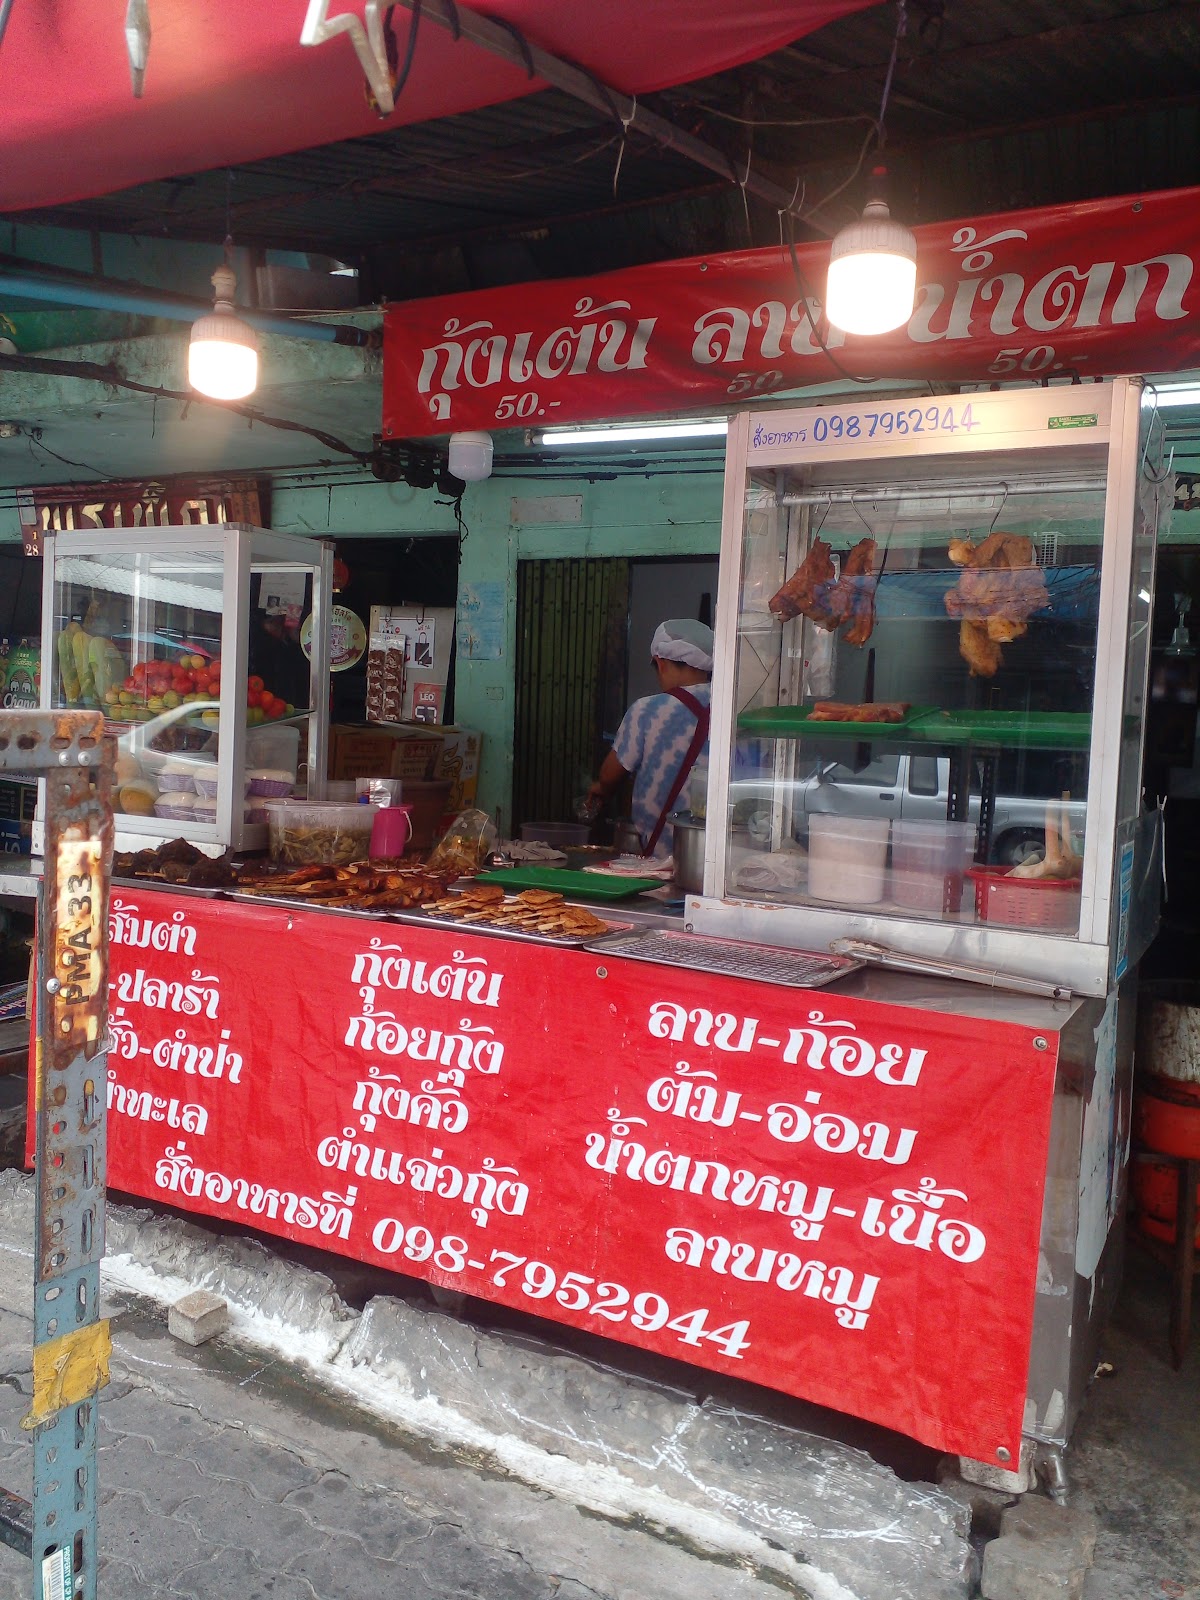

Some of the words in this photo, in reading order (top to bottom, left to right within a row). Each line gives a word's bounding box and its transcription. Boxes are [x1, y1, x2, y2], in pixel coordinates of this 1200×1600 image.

[417, 297, 658, 420] กุ้งเต้น
[907, 226, 1194, 343] น้ำตก
[495, 392, 562, 420] 50.-
[987, 345, 1088, 374] 50.-
[752, 422, 808, 449] สั่งอาหาร
[813, 403, 982, 442] 0987952944
[25, 544, 39, 557] 28
[420, 693, 434, 702] LEO
[67, 872, 92, 916] 33
[66, 927, 92, 1006] PMA
[351, 937, 504, 1008] กุ้งเต้น
[345, 1003, 506, 1087] ก้อยกุ้ง
[648, 1001, 928, 1087] ลาบ-ก้อย
[107, 1070, 208, 1136] ำทะเล
[351, 1066, 469, 1133] กุ้งคั่ว
[646, 1061, 919, 1165] ต้ม-อ่อม
[317, 1127, 529, 1229] ตำแจ่วกุ้ง
[584, 1108, 987, 1264] น้ำตกหมู-เนื้อ
[154, 1140, 358, 1240] สั่งอาหารที่
[372, 1218, 751, 1359] 098-7952944
[664, 1227, 881, 1331] ลาบหมู
